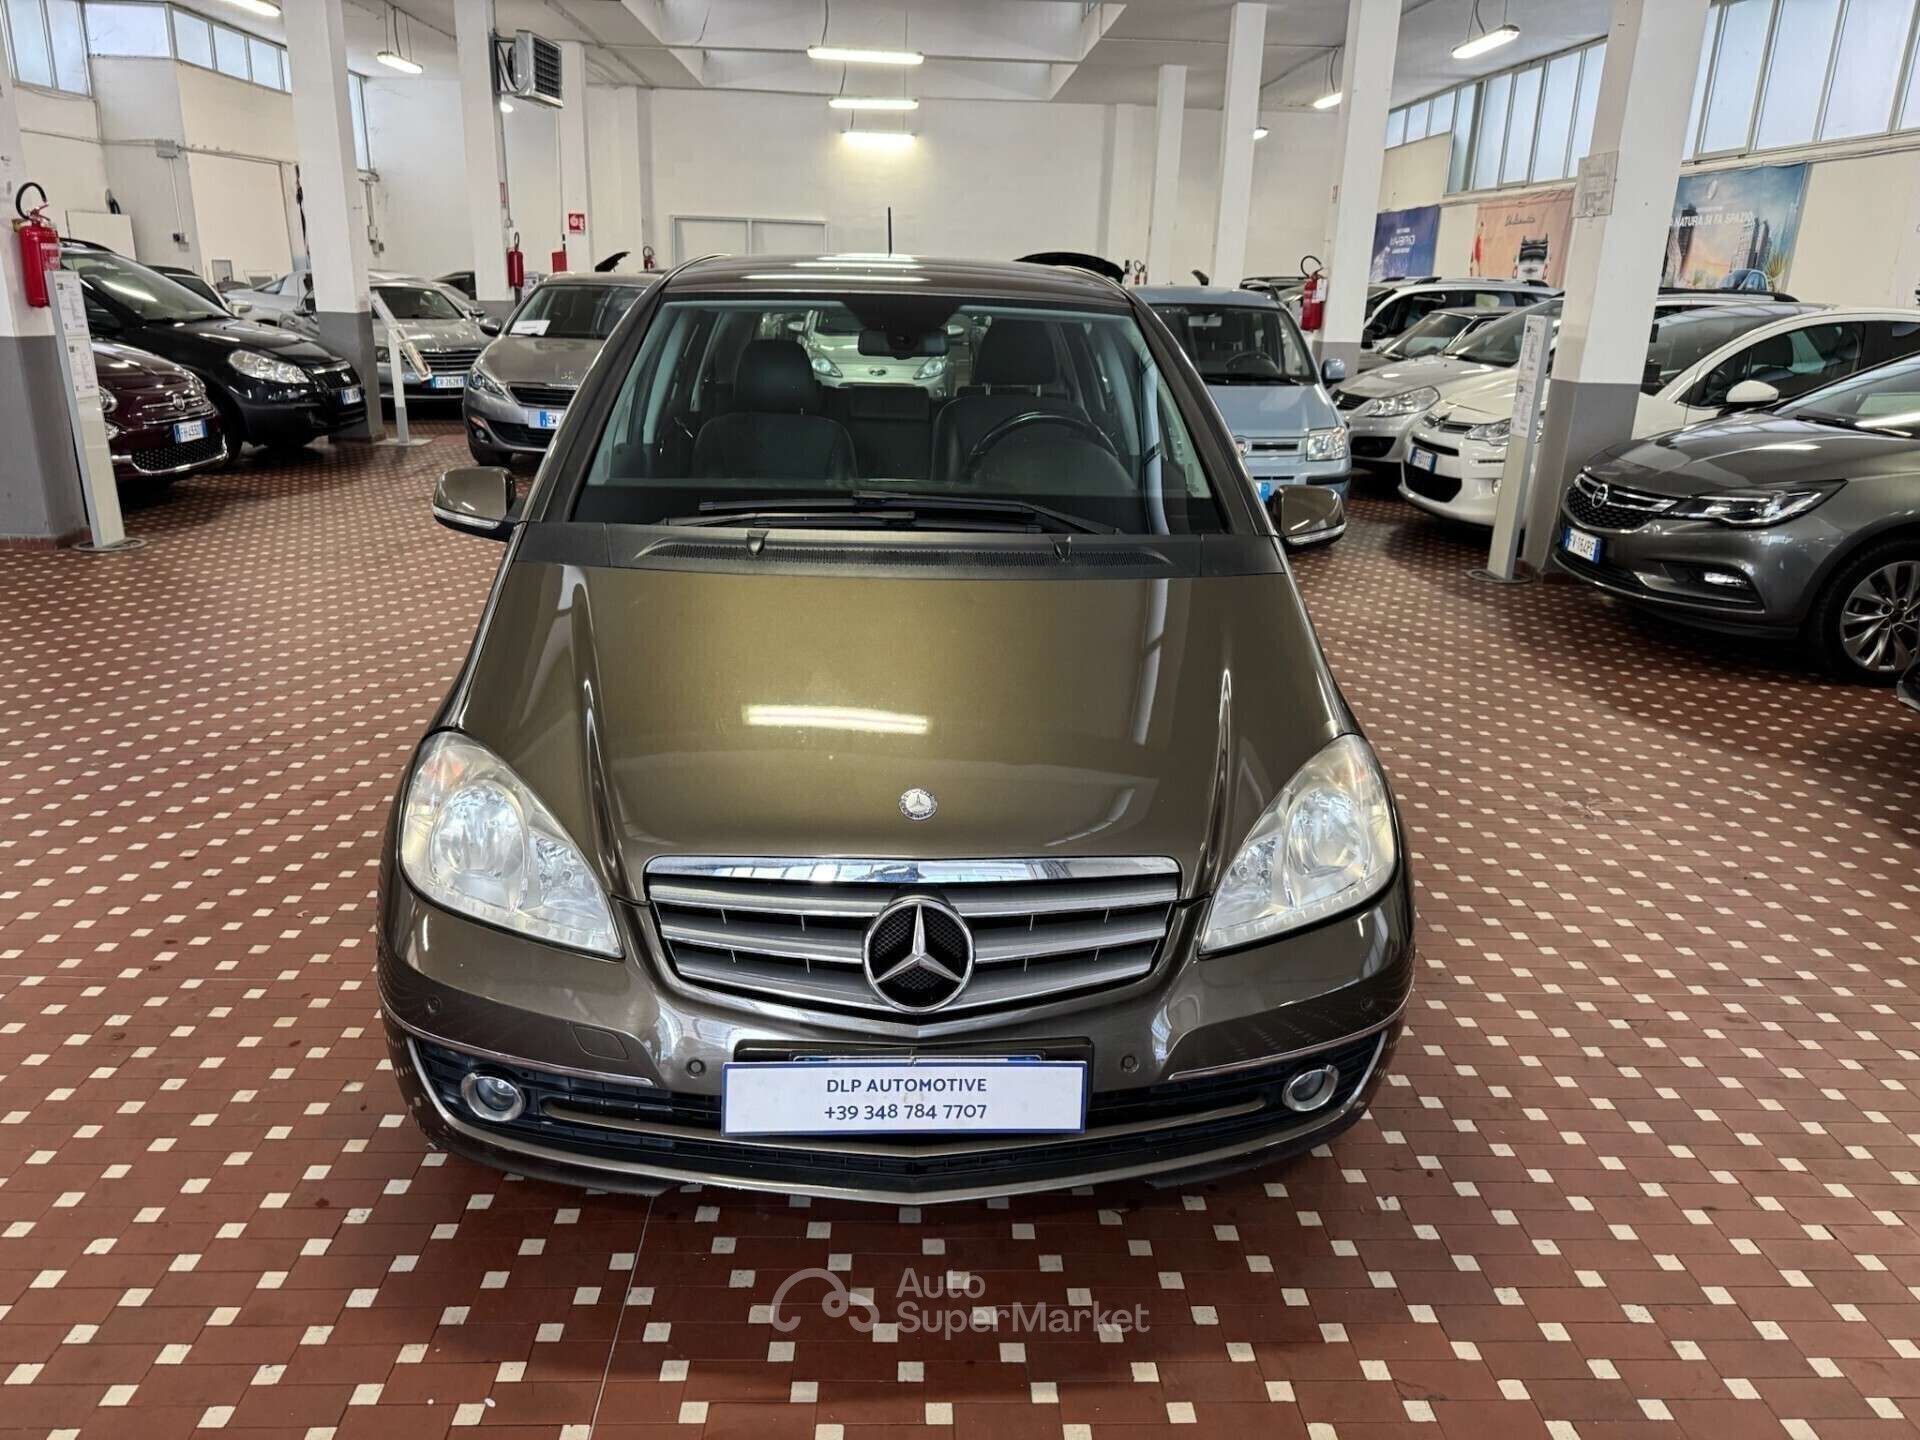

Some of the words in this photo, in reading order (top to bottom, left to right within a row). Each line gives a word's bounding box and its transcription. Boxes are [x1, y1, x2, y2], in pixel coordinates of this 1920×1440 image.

[826, 1078, 861, 1093] DLP
[866, 1078, 987, 1093] AUTOMOTIVE
[824, 1104, 858, 1121] +39
[863, 1104, 898, 1120] 348
[904, 1103, 937, 1120] 784
[943, 1103, 987, 1120] 7707
